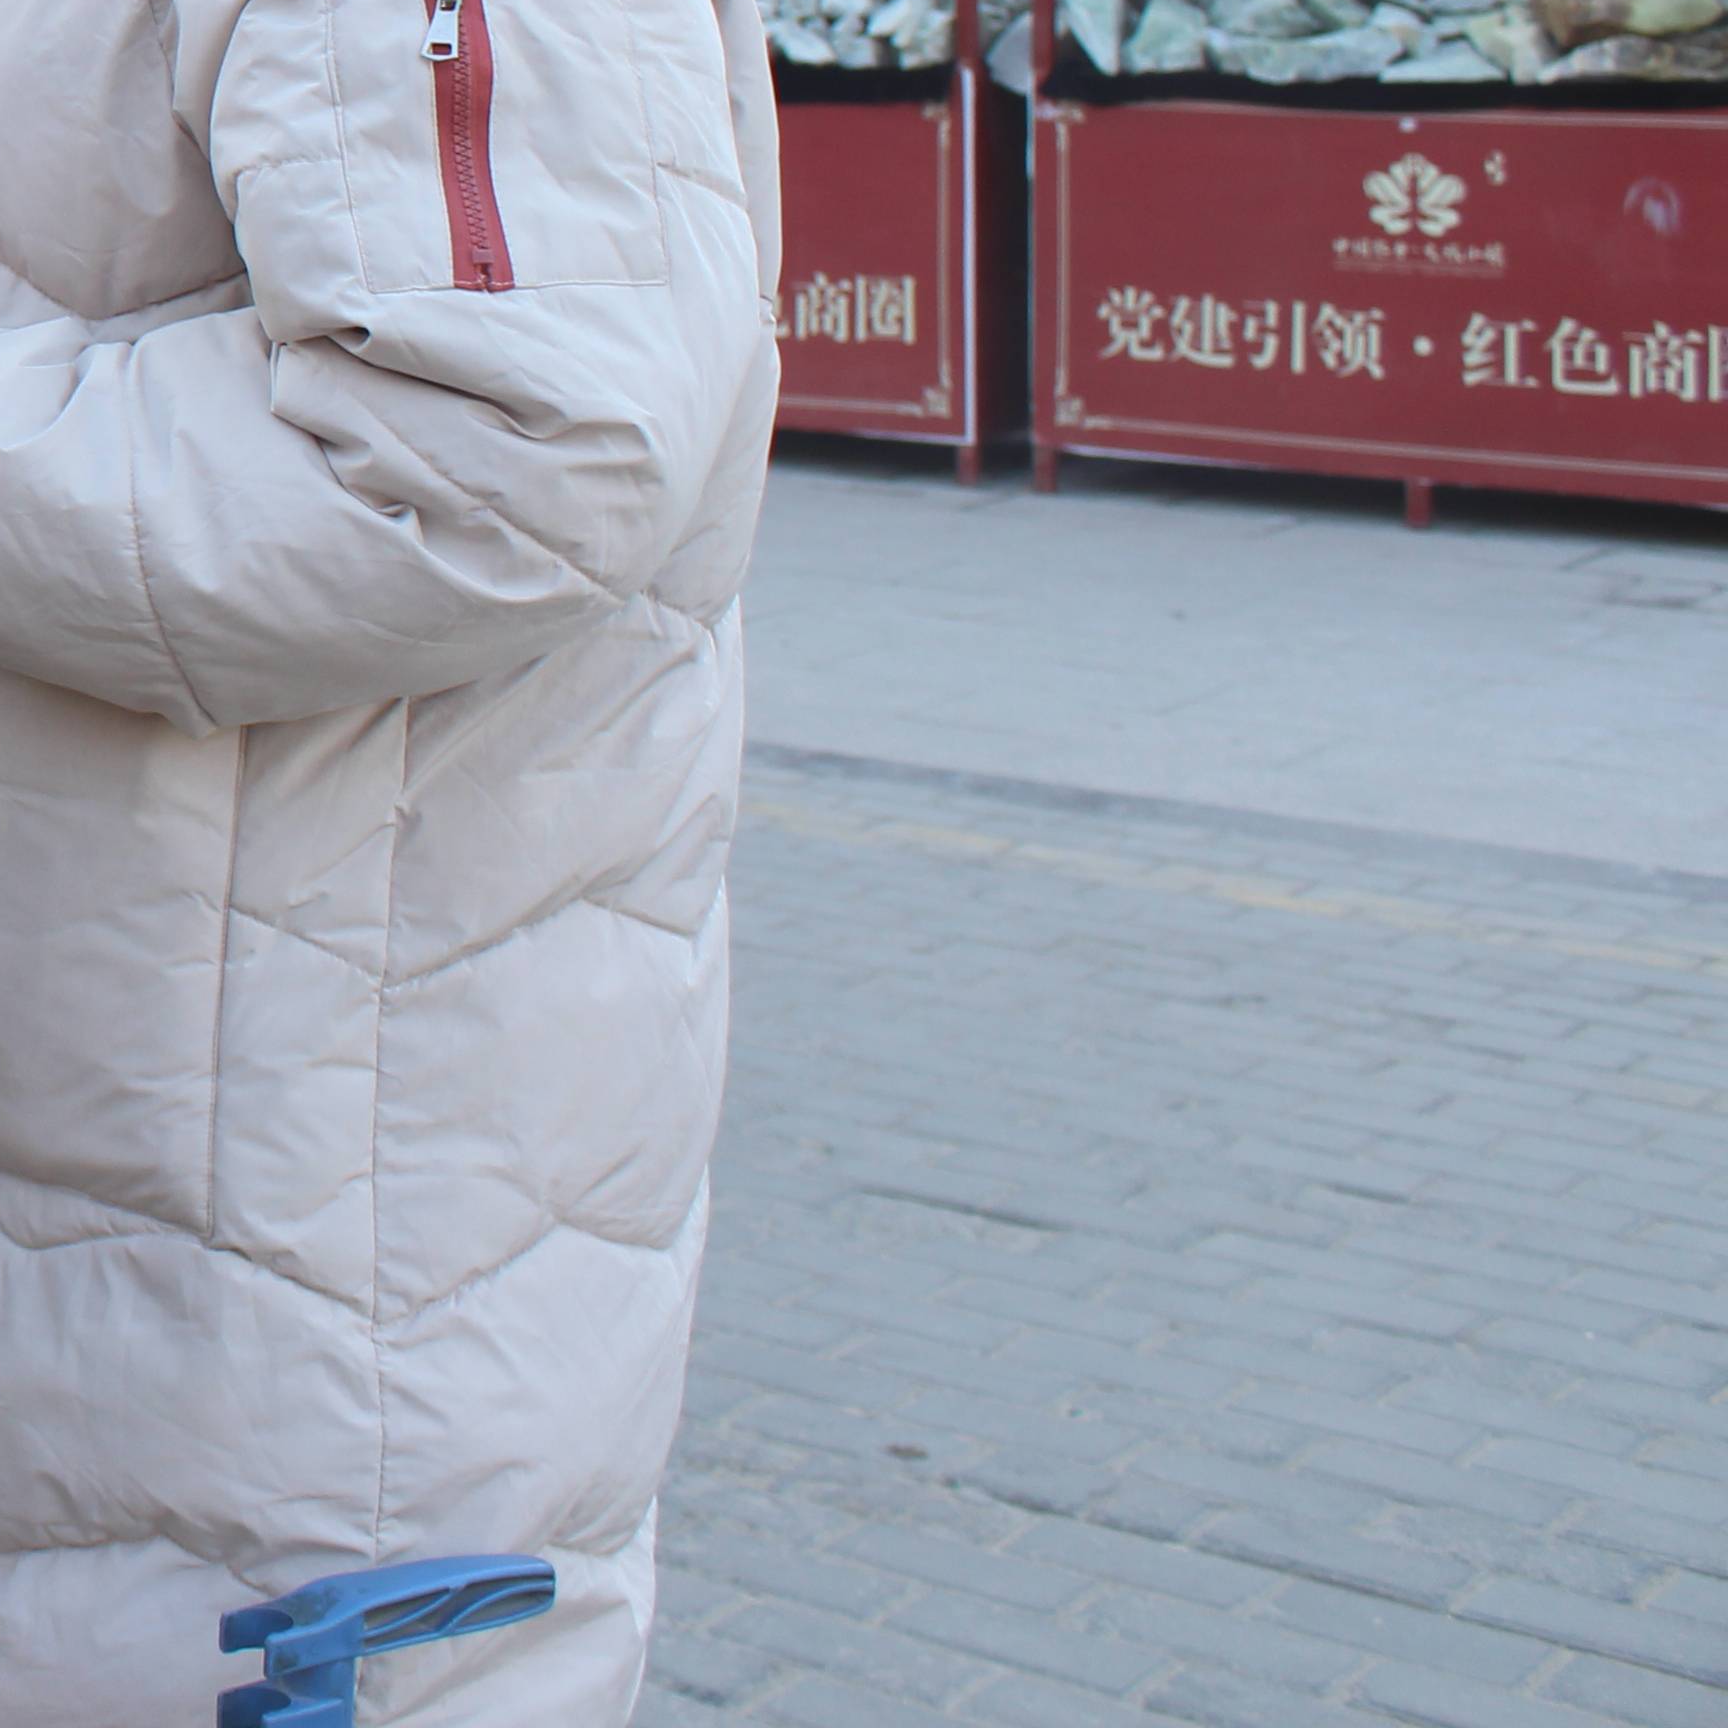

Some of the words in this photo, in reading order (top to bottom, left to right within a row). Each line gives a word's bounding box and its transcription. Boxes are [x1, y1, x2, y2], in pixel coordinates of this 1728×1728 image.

[1096, 285, 1728, 403] 党建引领·红色商
